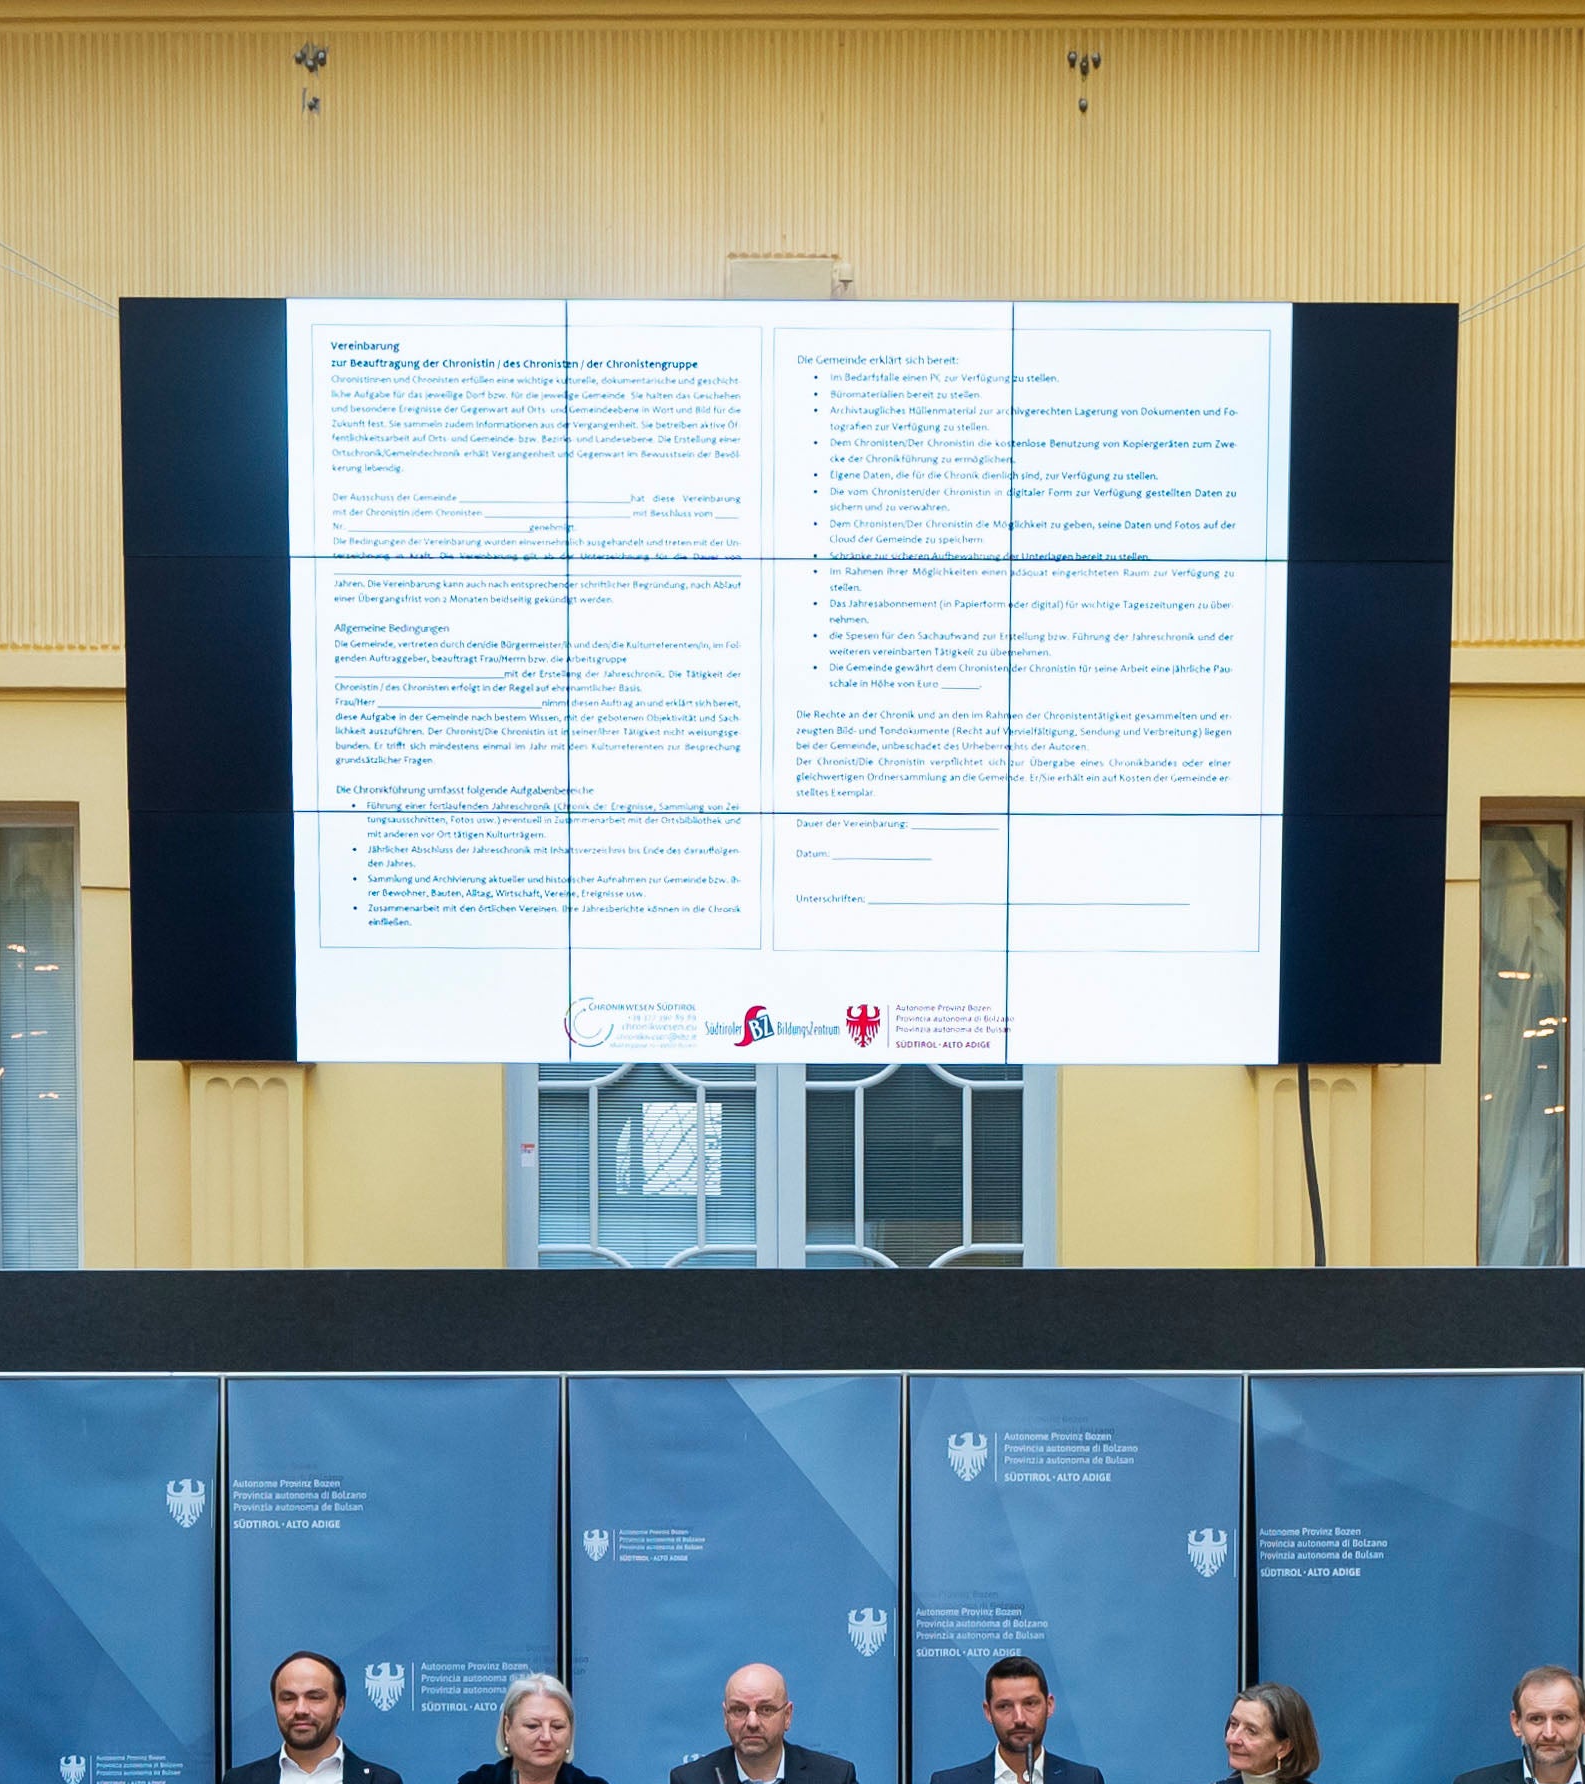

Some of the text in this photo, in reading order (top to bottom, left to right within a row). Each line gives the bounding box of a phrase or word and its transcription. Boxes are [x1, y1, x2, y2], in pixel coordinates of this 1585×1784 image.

[331, 341, 400, 353] Vereinbarung
[797, 355, 959, 365] Die Gemeinde erklärt sich bereit:
[331, 359, 698, 371] zur Beauftragung der Chronistin des Chronisten der Chronistengruppe
[907, 390, 933, 399] bereit
[334, 624, 450, 635] Allgemeine Bedingungen
[336, 786, 351, 794] Die
[354, 786, 425, 796] Chronikführung
[428, 786, 464, 795] umfasst
[467, 786, 508, 796] folgende
[796, 819, 822, 827] Dauer
[826, 819, 840, 827] der
[705, 1021, 742, 1036] Südtiroler
[748, 1015, 774, 1041] BZ
[1004, 1444, 1138, 1452] Provincia autonoma di Bolzano
[1004, 1456, 1134, 1464] Provinzia autonoma de Bulsan
[1004, 1472, 1111, 1482] SÜDTIROL ALTO ADIGE
[233, 1479, 340, 1488] Autonome Provinz Bozen
[233, 1491, 367, 1499] Provincia autonoma di Bolzano
[233, 1503, 363, 1511] Provinzia autonoma de Bulsan
[233, 1519, 340, 1529] SÜDTIROL ALTO ADIGE
[1259, 1527, 1361, 1536] Autonome Provinz Bozen
[1260, 1539, 1387, 1547] Provincia autonoma di Bolzano
[1260, 1551, 1384, 1559] Provinzia autonoma de Bulsan
[1261, 1568, 1361, 1577] SÜDTIROL ALTO ADIGE
[916, 1608, 1022, 1616] Autonome Provinz Bozen
[916, 1620, 1048, 1628] Provincia autonoma di Bolzano
[916, 1631, 1044, 1639] Provinzia autonoma de Bulsan
[917, 1648, 1021, 1657] SÜDTIROL ALTO ADIGE
[421, 1662, 528, 1671] Autonome Provinz Bozen
[422, 1674, 460, 1682] Provincia
[463, 1674, 506, 1682] autonoma
[422, 1686, 506, 1694] Provinzia autonoma
[422, 1702, 468, 1712] SÜDTIROL
[474, 1702, 497, 1712] ALTO
